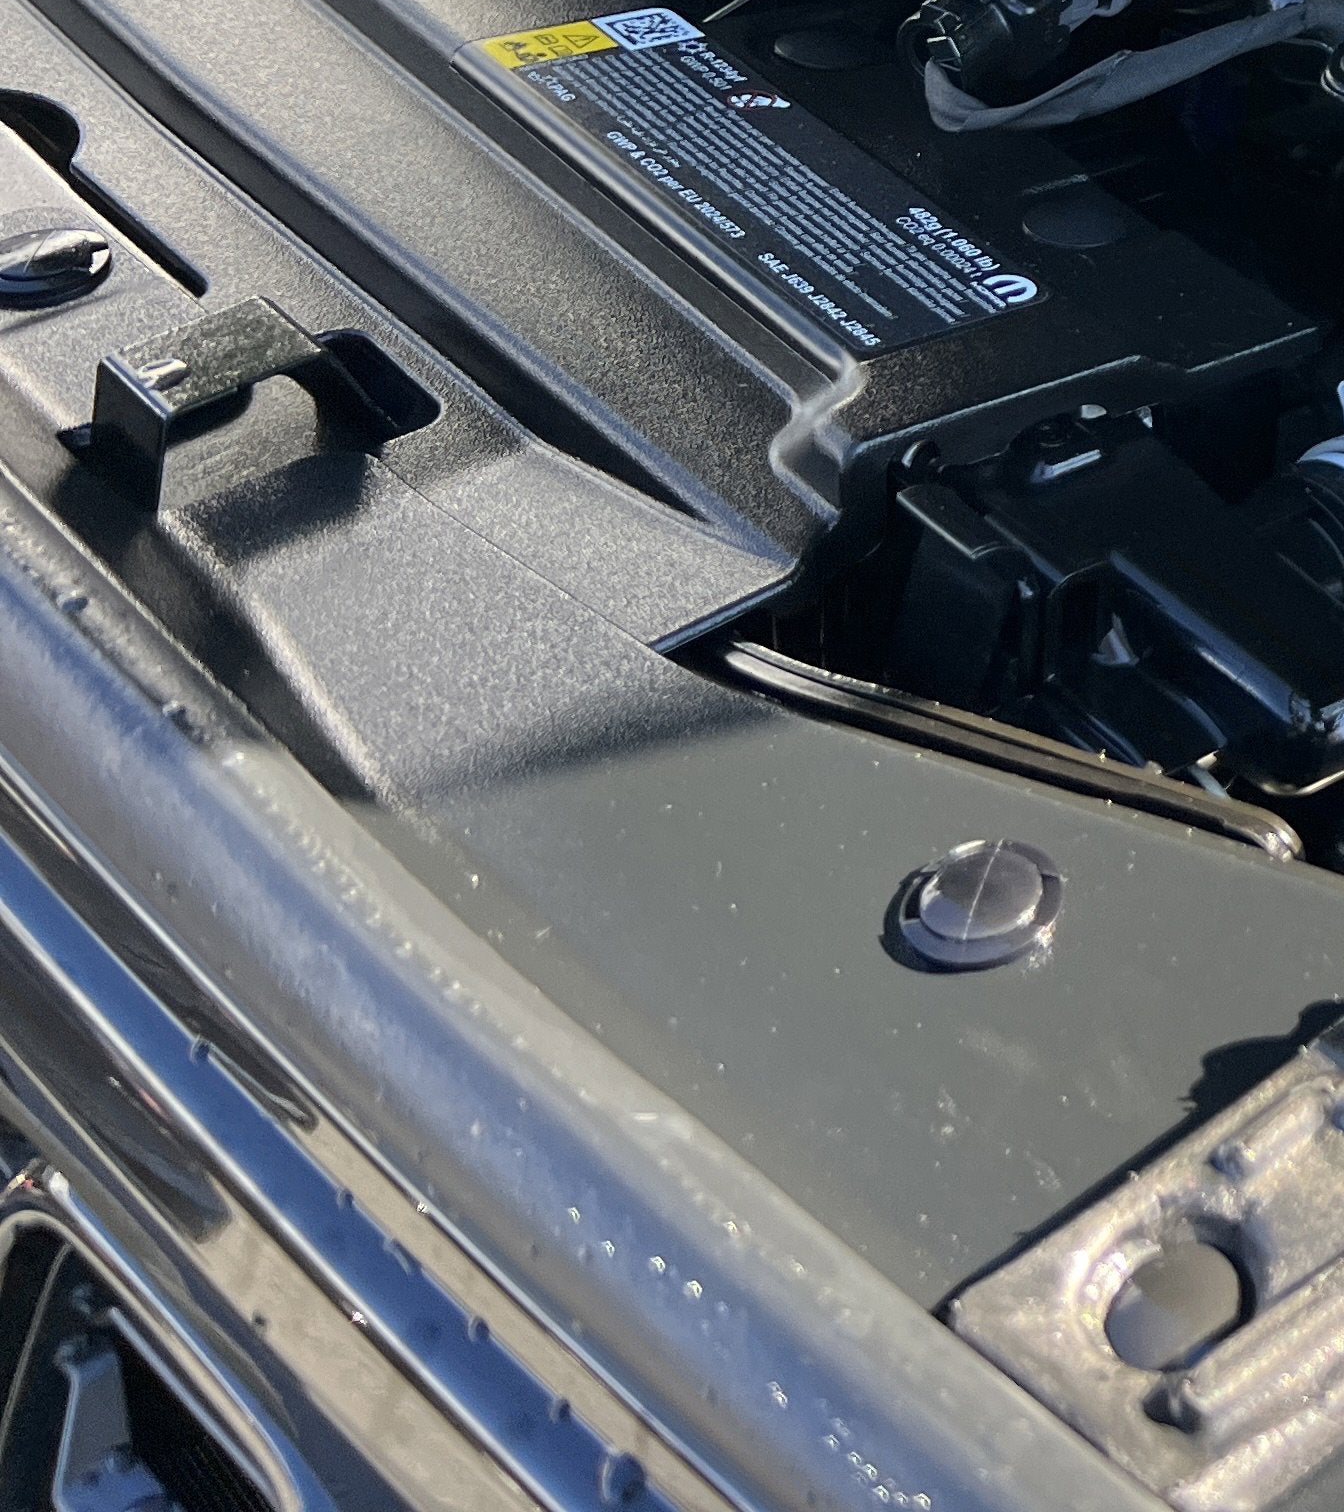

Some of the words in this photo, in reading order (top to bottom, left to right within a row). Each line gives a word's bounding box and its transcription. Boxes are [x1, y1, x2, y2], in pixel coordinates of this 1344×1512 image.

[640, 158, 669, 176] CO2
[658, 175, 684, 190] per
[678, 189, 703, 203] EU
[895, 216, 925, 234] CO2
[917, 234, 936, 246] eq
[758, 252, 789, 273] SAE
[781, 273, 814, 293] J639
[807, 294, 847, 320] J2842
